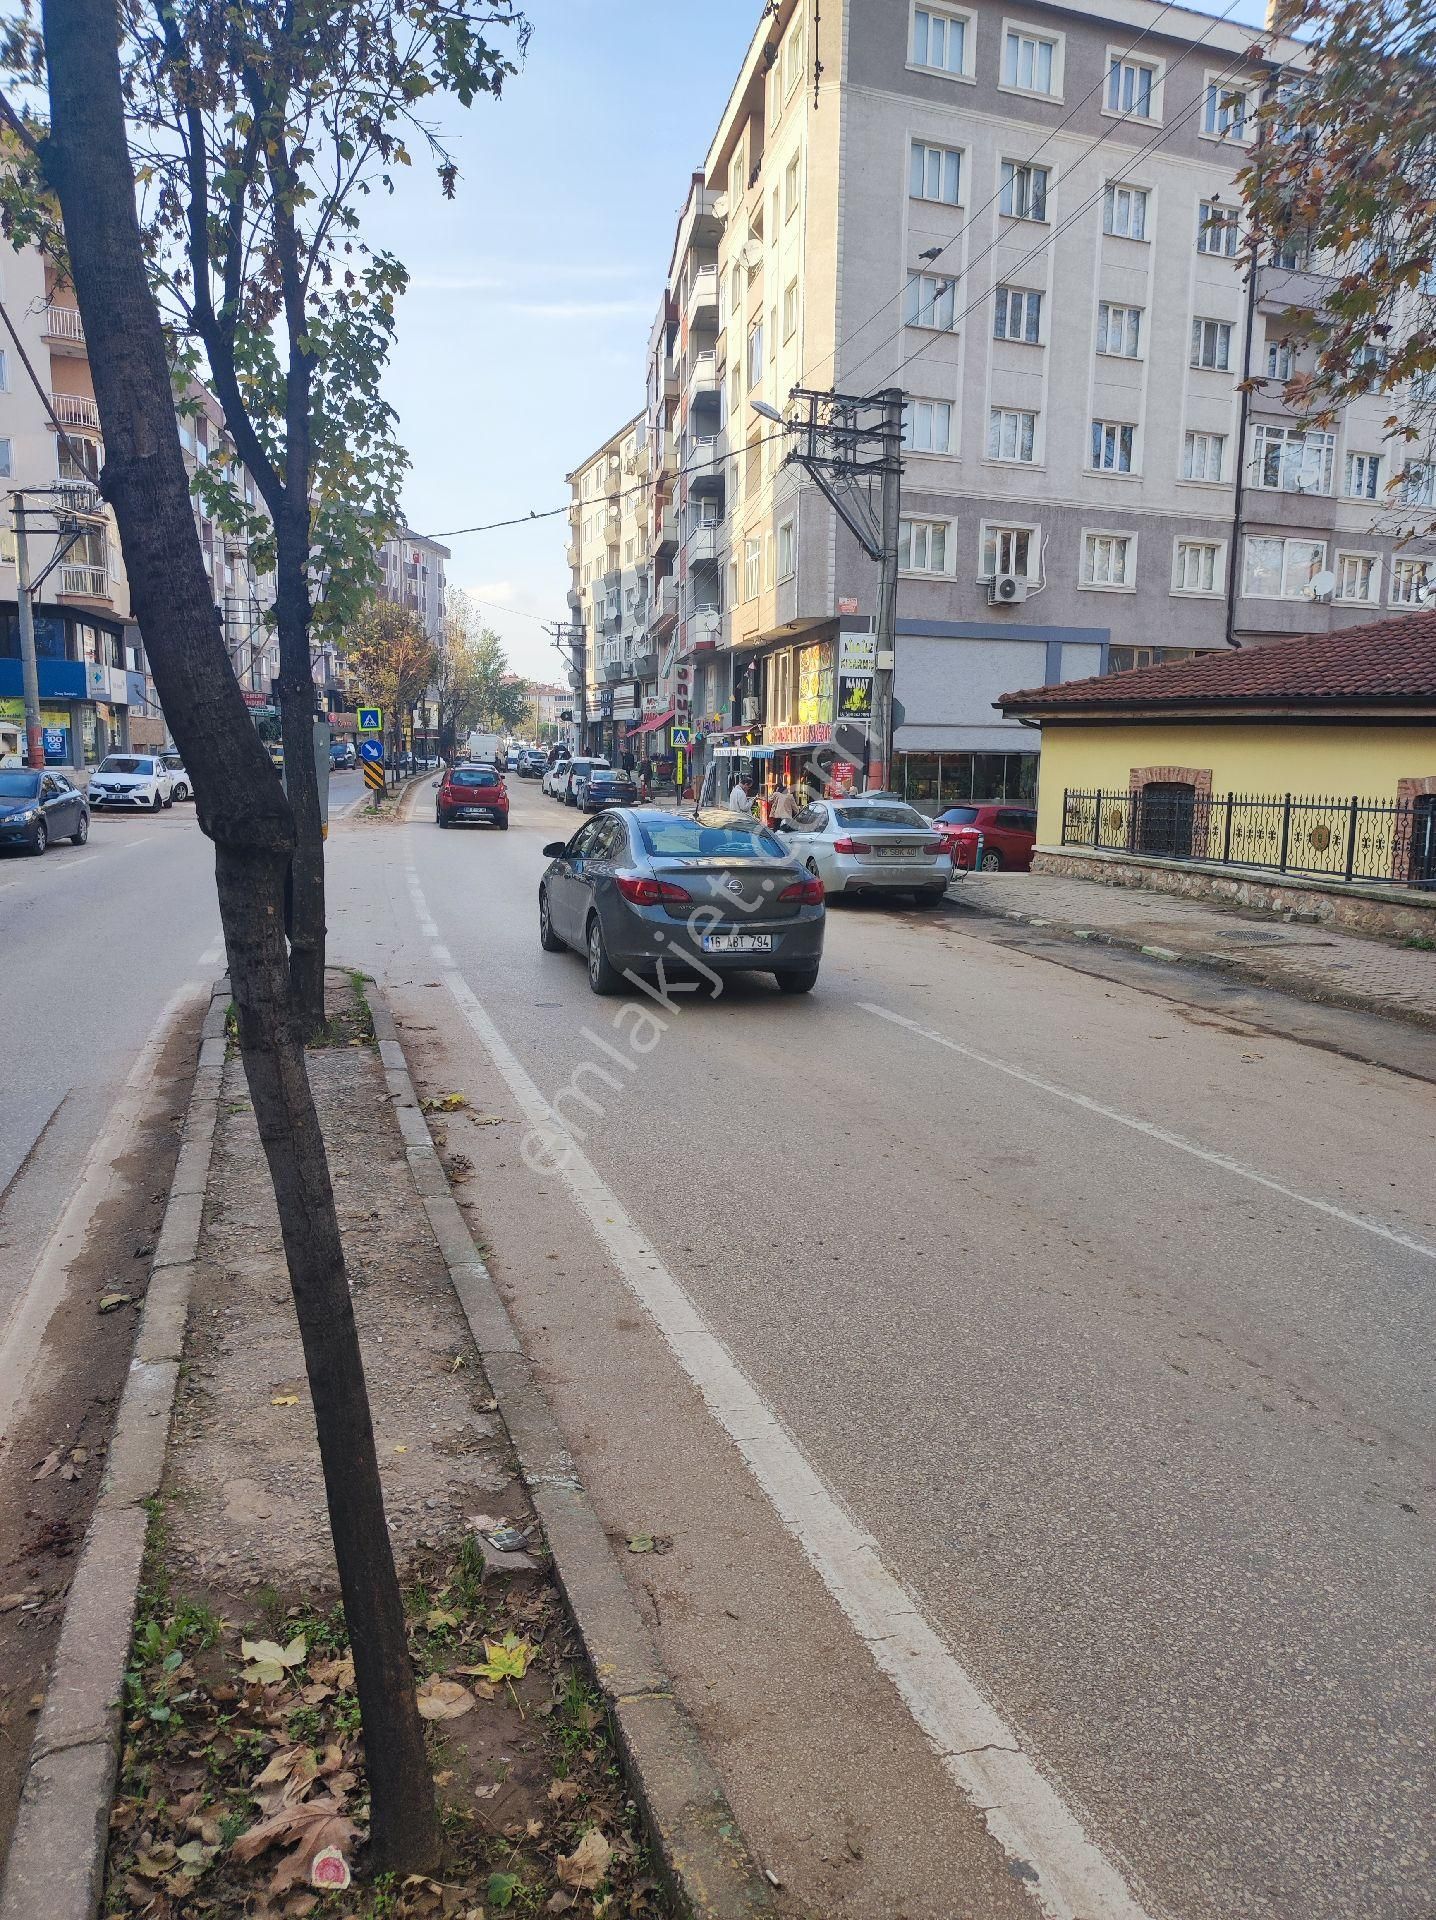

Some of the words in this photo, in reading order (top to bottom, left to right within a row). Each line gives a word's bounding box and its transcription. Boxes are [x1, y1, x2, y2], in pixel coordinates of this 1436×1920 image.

[710, 936, 721, 949] 16
[727, 935, 745, 949] ABT
[751, 935, 769, 949] 794
